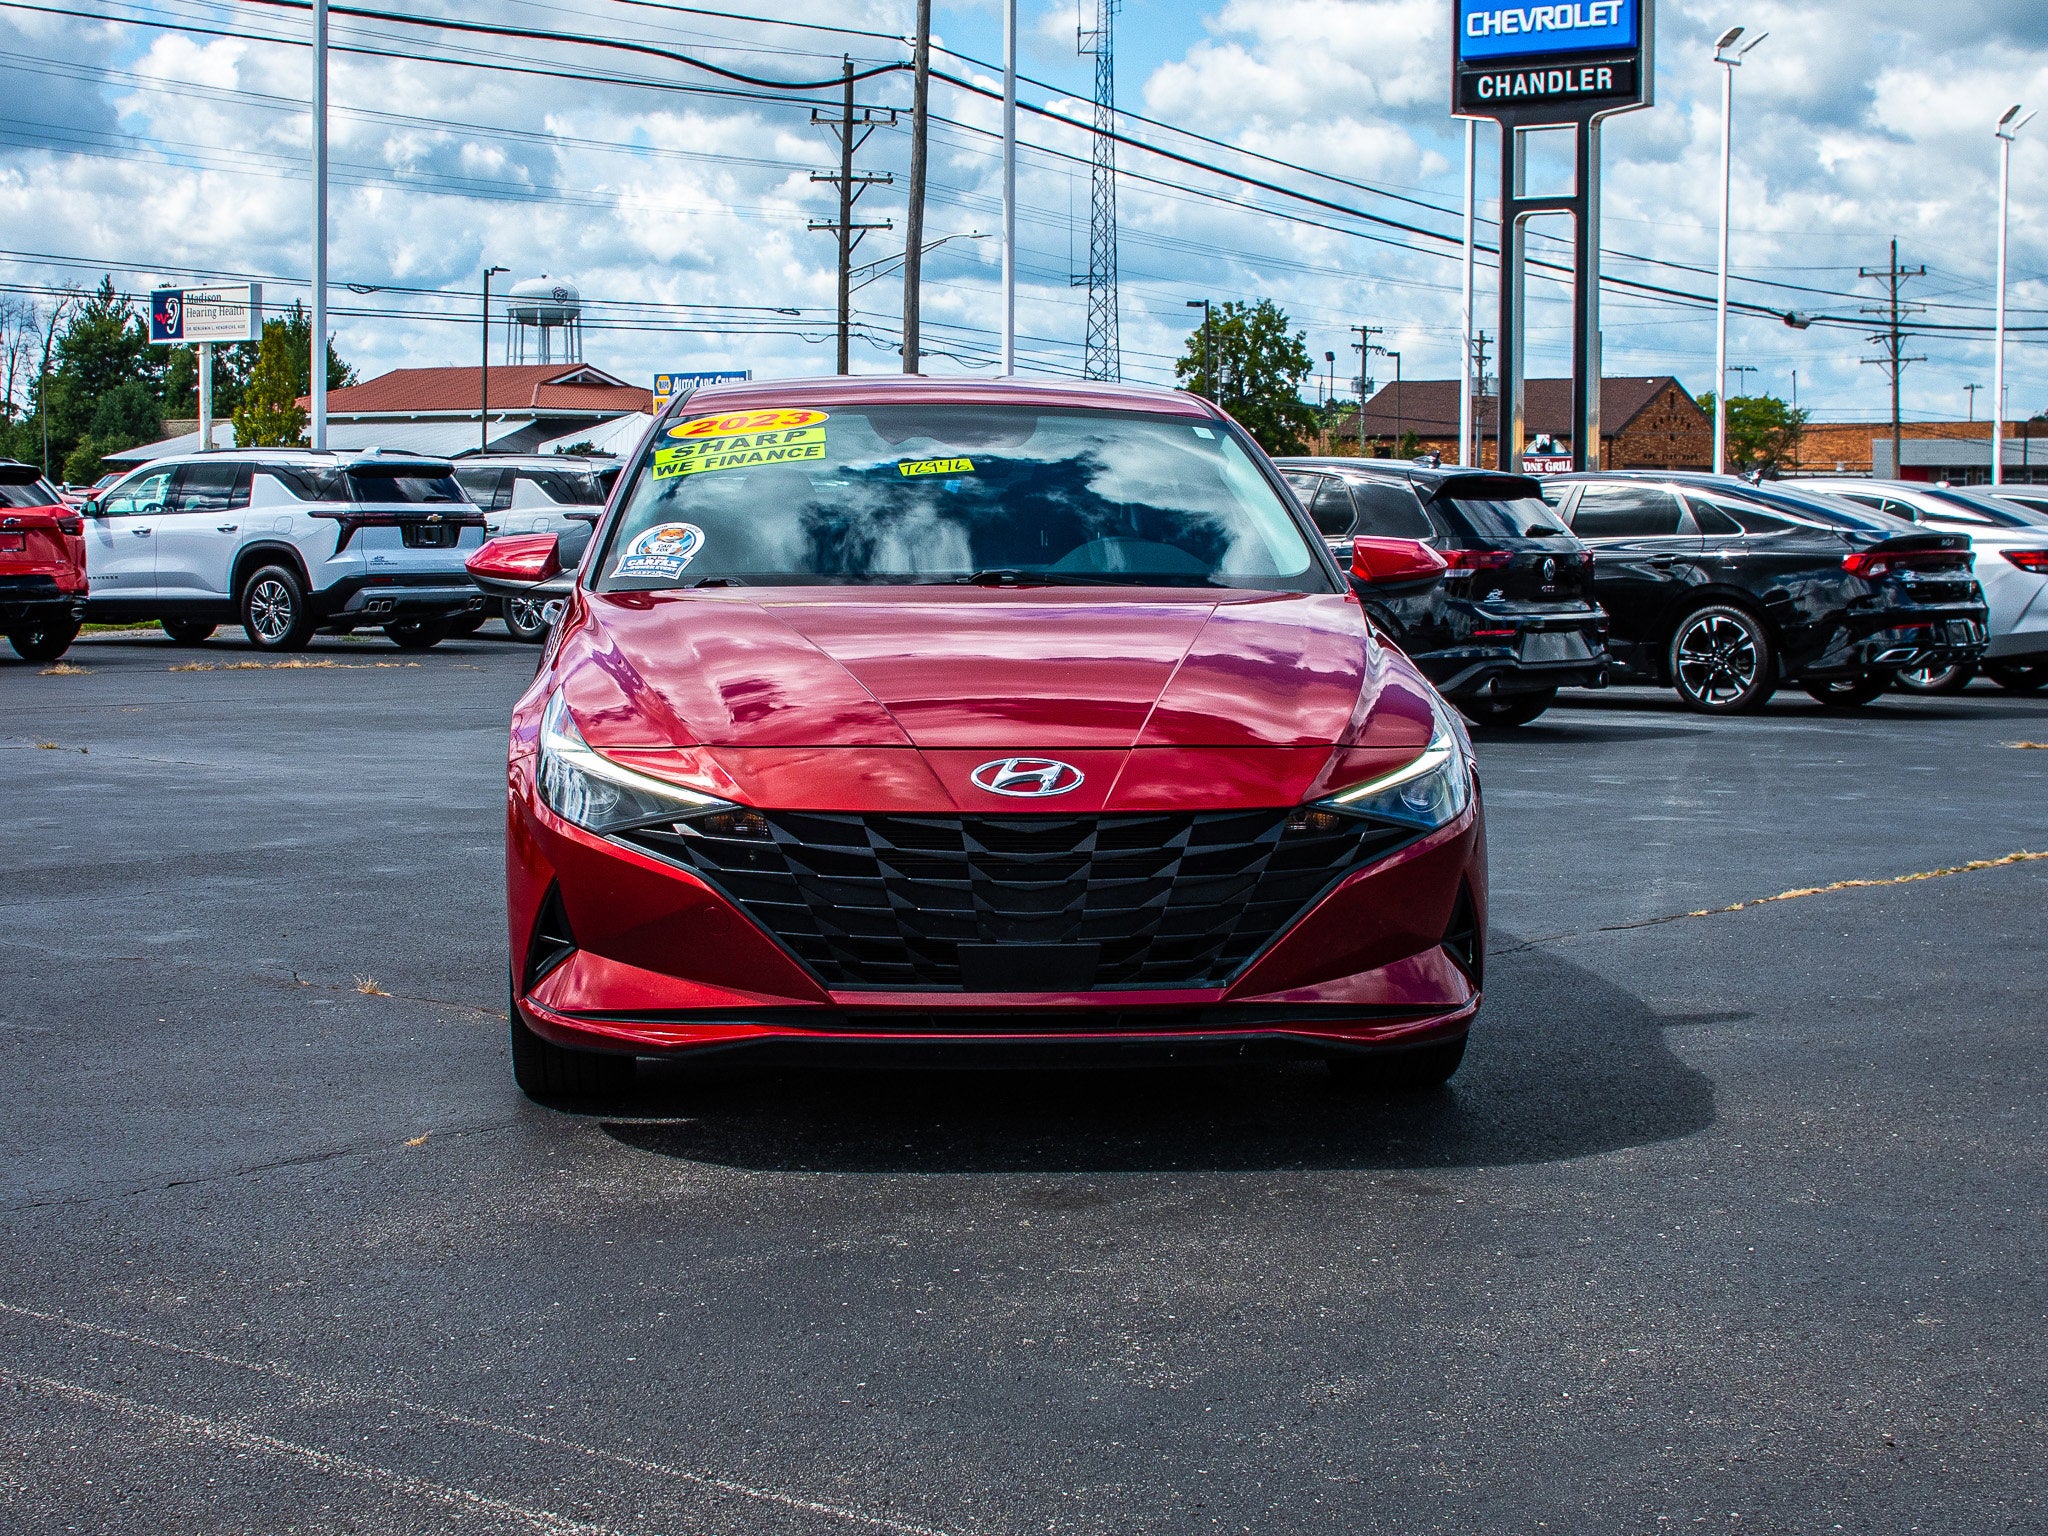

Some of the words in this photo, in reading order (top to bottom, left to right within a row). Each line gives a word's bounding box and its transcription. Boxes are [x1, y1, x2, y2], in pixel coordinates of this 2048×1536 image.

[1467, 0, 1623, 37] CHEVROLET
[1478, 67, 1612, 98] CHANDLER
[186, 293, 222, 304] Madison
[186, 306, 217, 319] Hearing
[219, 305, 245, 316] Health
[685, 412, 812, 435] 2023
[671, 430, 807, 459] SHARP
[656, 461, 694, 476] WE
[705, 446, 820, 469] FINANCE
[1545, 460, 1572, 472] GRILL
